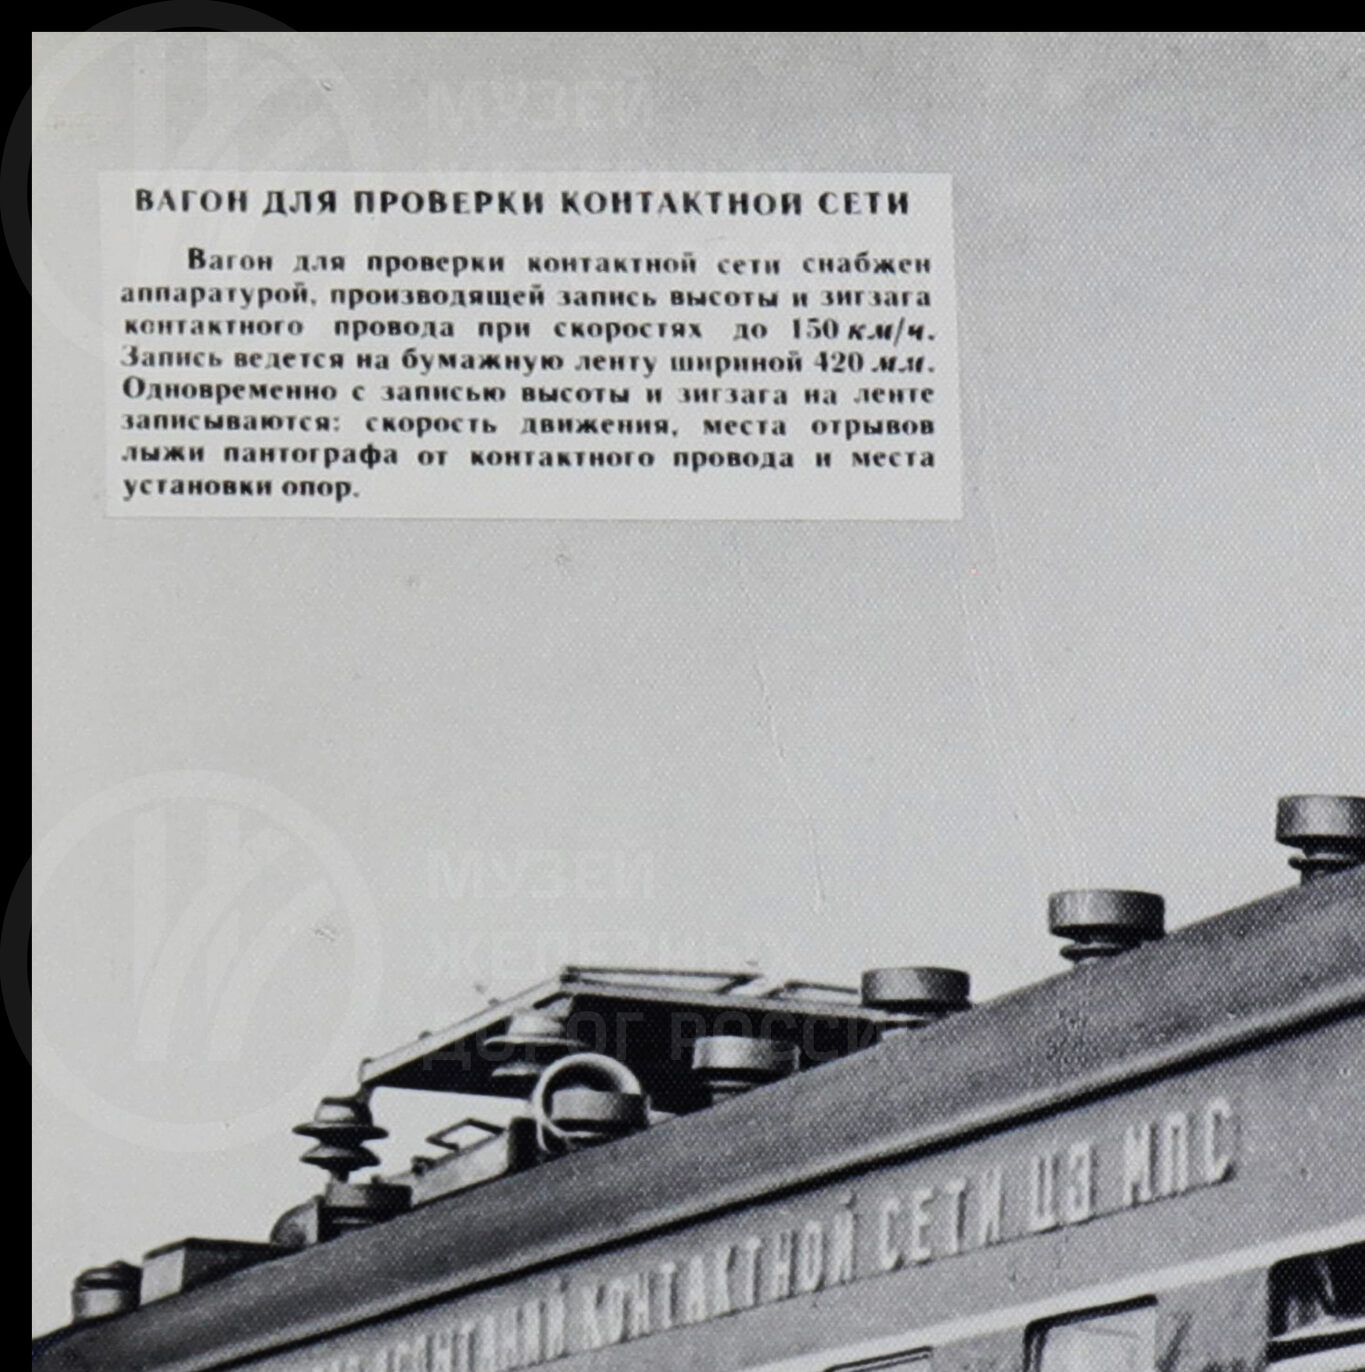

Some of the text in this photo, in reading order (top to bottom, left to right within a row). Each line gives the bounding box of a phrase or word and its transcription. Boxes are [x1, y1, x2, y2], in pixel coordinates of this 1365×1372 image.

[135, 188, 909, 217] ВАГОН ДЛЯ ПРОВЕРКИ КОНТАКТНОЙ СЕТИ
[187, 246, 931, 278] Вагон для проверки контактной сети снабжен
[120, 281, 932, 311] аппаратурой, производящей запись высоты и зигзага
[124, 316, 936, 347] контактного провода при скоростях до 150 км/ч.
[120, 345, 935, 379] Запись ведется на бумажную ленту шириной 420 мм.
[122, 375, 935, 406] Одновременно с записью высоты и зигзага на ленте
[124, 413, 935, 442] записываются: скорость движения, места отрывов
[121, 442, 935, 474] лыжи пантографа от контактного провода и места
[123, 478, 360, 504] установки опор.
[877, 1168, 1003, 1272] СЕТИ
[1121, 1097, 1236, 1207] МПС
